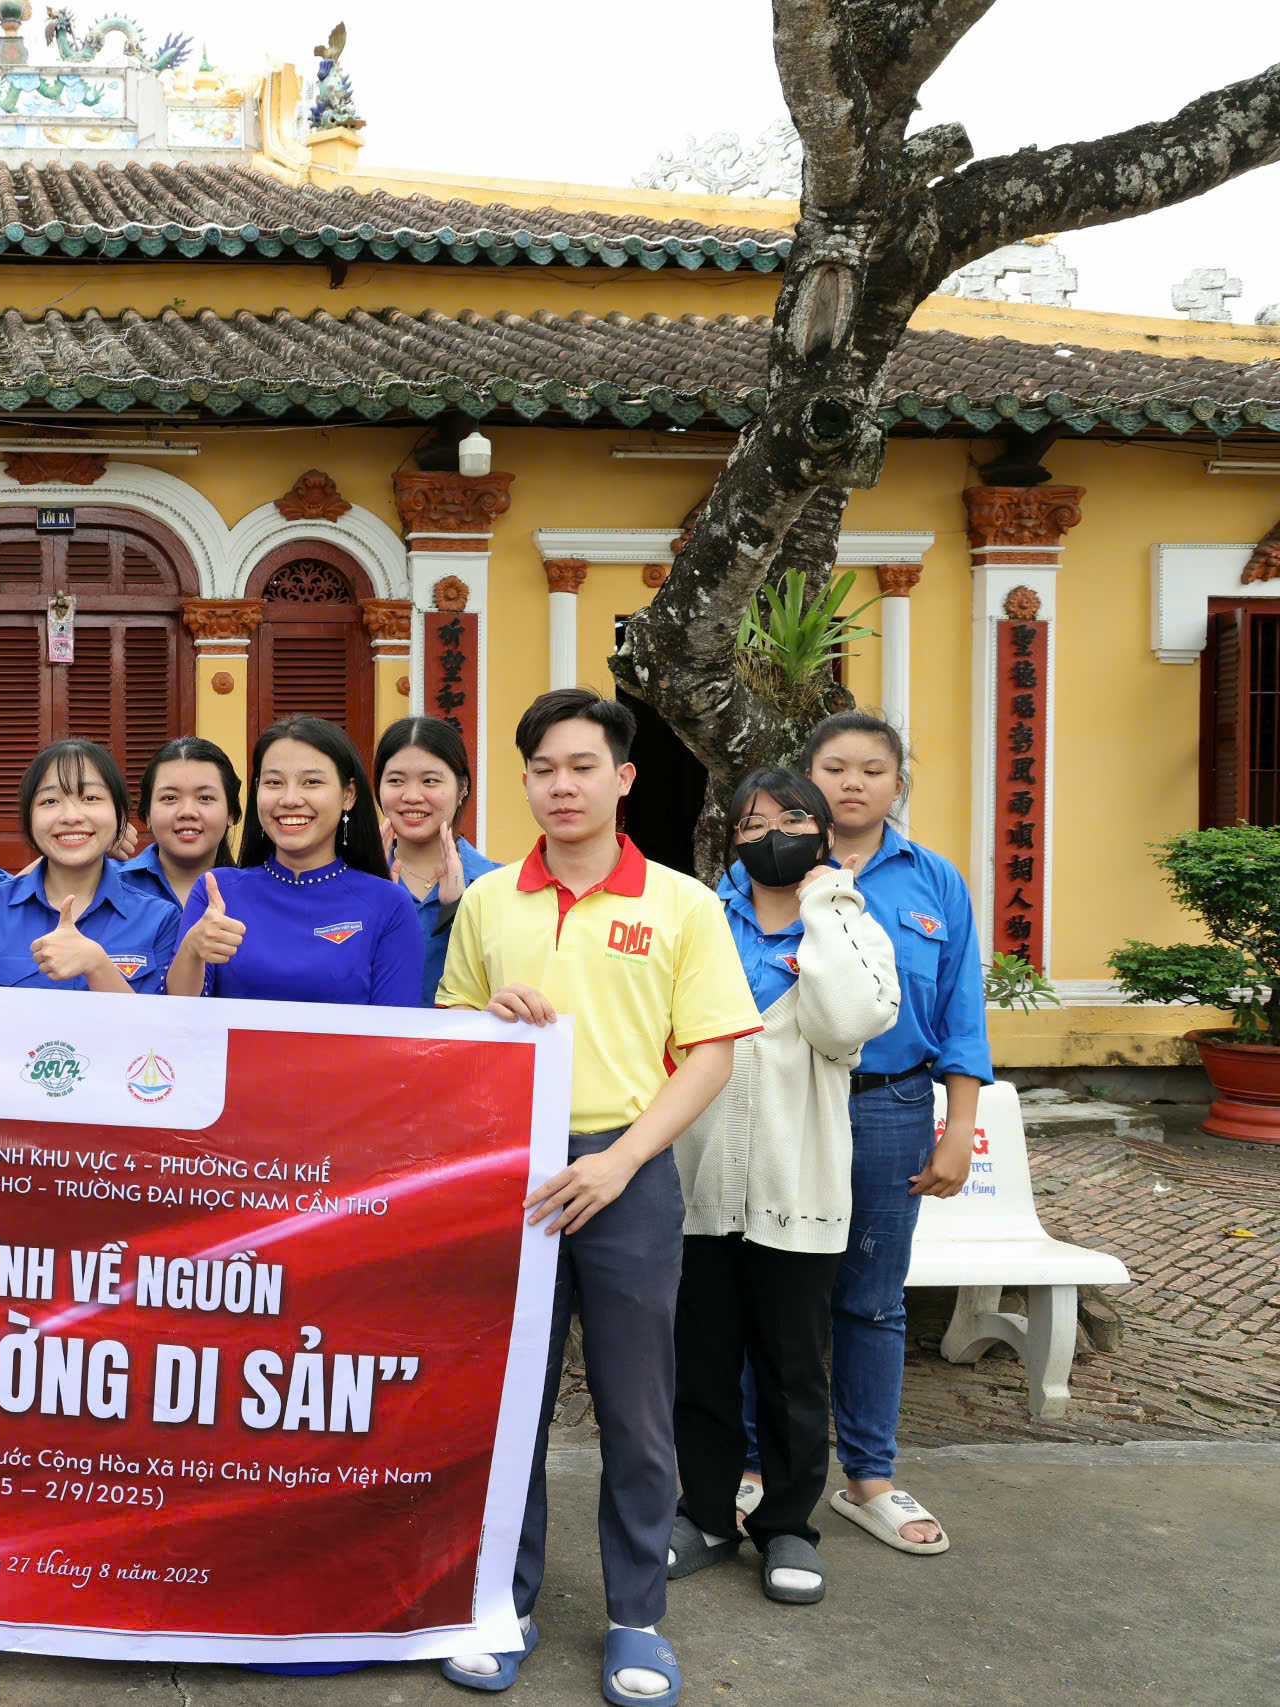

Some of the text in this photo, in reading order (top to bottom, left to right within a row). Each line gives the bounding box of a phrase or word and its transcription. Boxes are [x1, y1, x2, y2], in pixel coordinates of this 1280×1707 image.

[42, 510, 70, 524] LỐI RA
[608, 919, 653, 957] DNC
[30, 1149, 70, 1169] KHU
[75, 1150, 118, 1175] VỰC
[123, 1154, 136, 1172] 4
[160, 1154, 248, 1179] PHƯỜNG
[254, 1154, 288, 1182] CÁI
[295, 1155, 331, 1183] KHẾ
[54, 1177, 142, 1202] TRƯỜNG
[146, 1185, 182, 1208] ĐẠI
[189, 1188, 235, 1211] HỌC
[240, 1191, 289, 1211] NAM
[295, 1188, 340, 1214] CẦN
[345, 1196, 389, 1216] THƠ
[70, 1240, 128, 1305] VỀ
[136, 1249, 283, 1315] NGUỒN
[153, 1343, 219, 1425] DI
[240, 1325, 419, 1433] SẢN”
[37, 1449, 92, 1475] Cộng
[99, 1453, 140, 1474] Hòa
[146, 1457, 174, 1477] Xã
[181, 1460, 214, 1483] Hội
[220, 1461, 260, 1482] Chủ
[268, 1465, 330, 1489] Nghĩa
[337, 1466, 378, 1489] Việt
[384, 1467, 432, 1484] Nam
[45, 1480, 165, 1510] 2/9/2025)
[7, 1556, 31, 1573] 27
[36, 1549, 93, 1589] tháng
[99, 1563, 109, 1579] 8
[116, 1564, 161, 1581] năm
[163, 1567, 210, 1585] 2025
